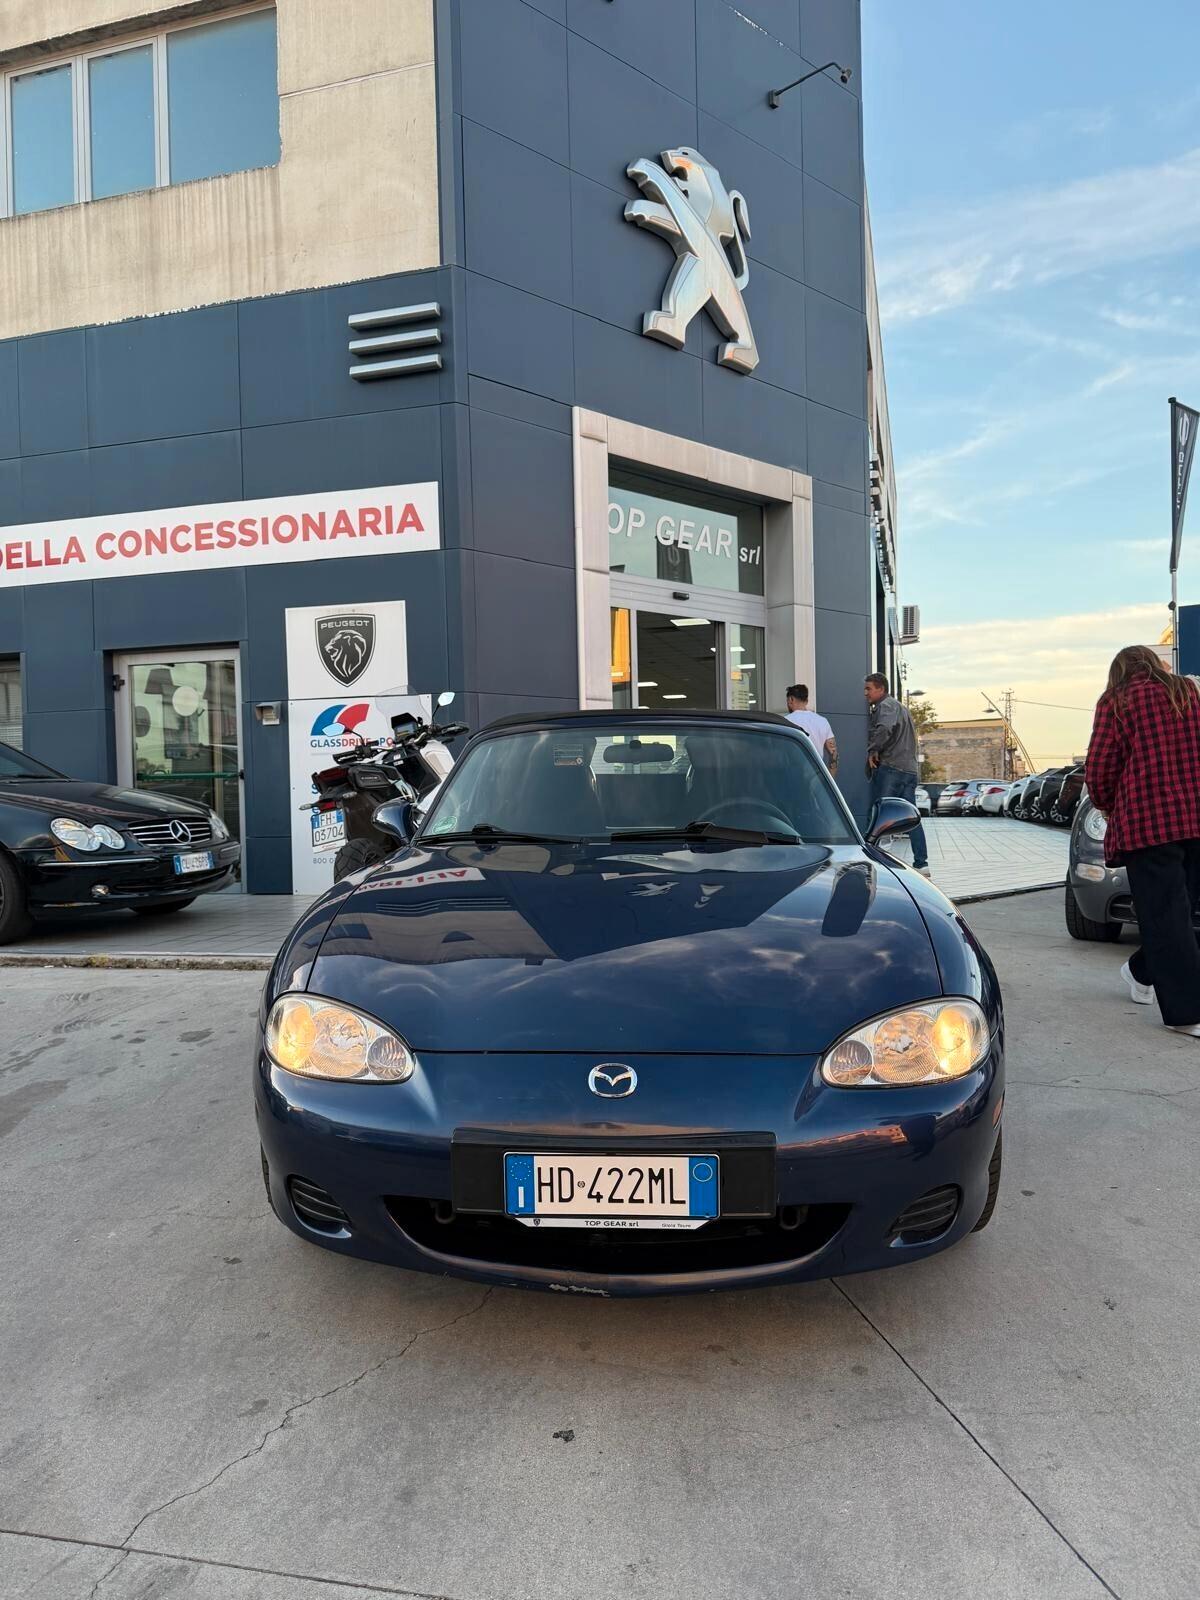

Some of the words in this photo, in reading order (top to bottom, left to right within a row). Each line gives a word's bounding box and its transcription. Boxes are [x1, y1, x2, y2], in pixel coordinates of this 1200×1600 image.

[0, 535, 86, 570] ELLA
[95, 502, 425, 561] CONCESSIONARIA
[607, 502, 646, 537] OP
[656, 515, 733, 558] GEAR
[739, 545, 761, 566] srl
[320, 620, 370, 629] PEUGEOT
[314, 825, 344, 843] 03704
